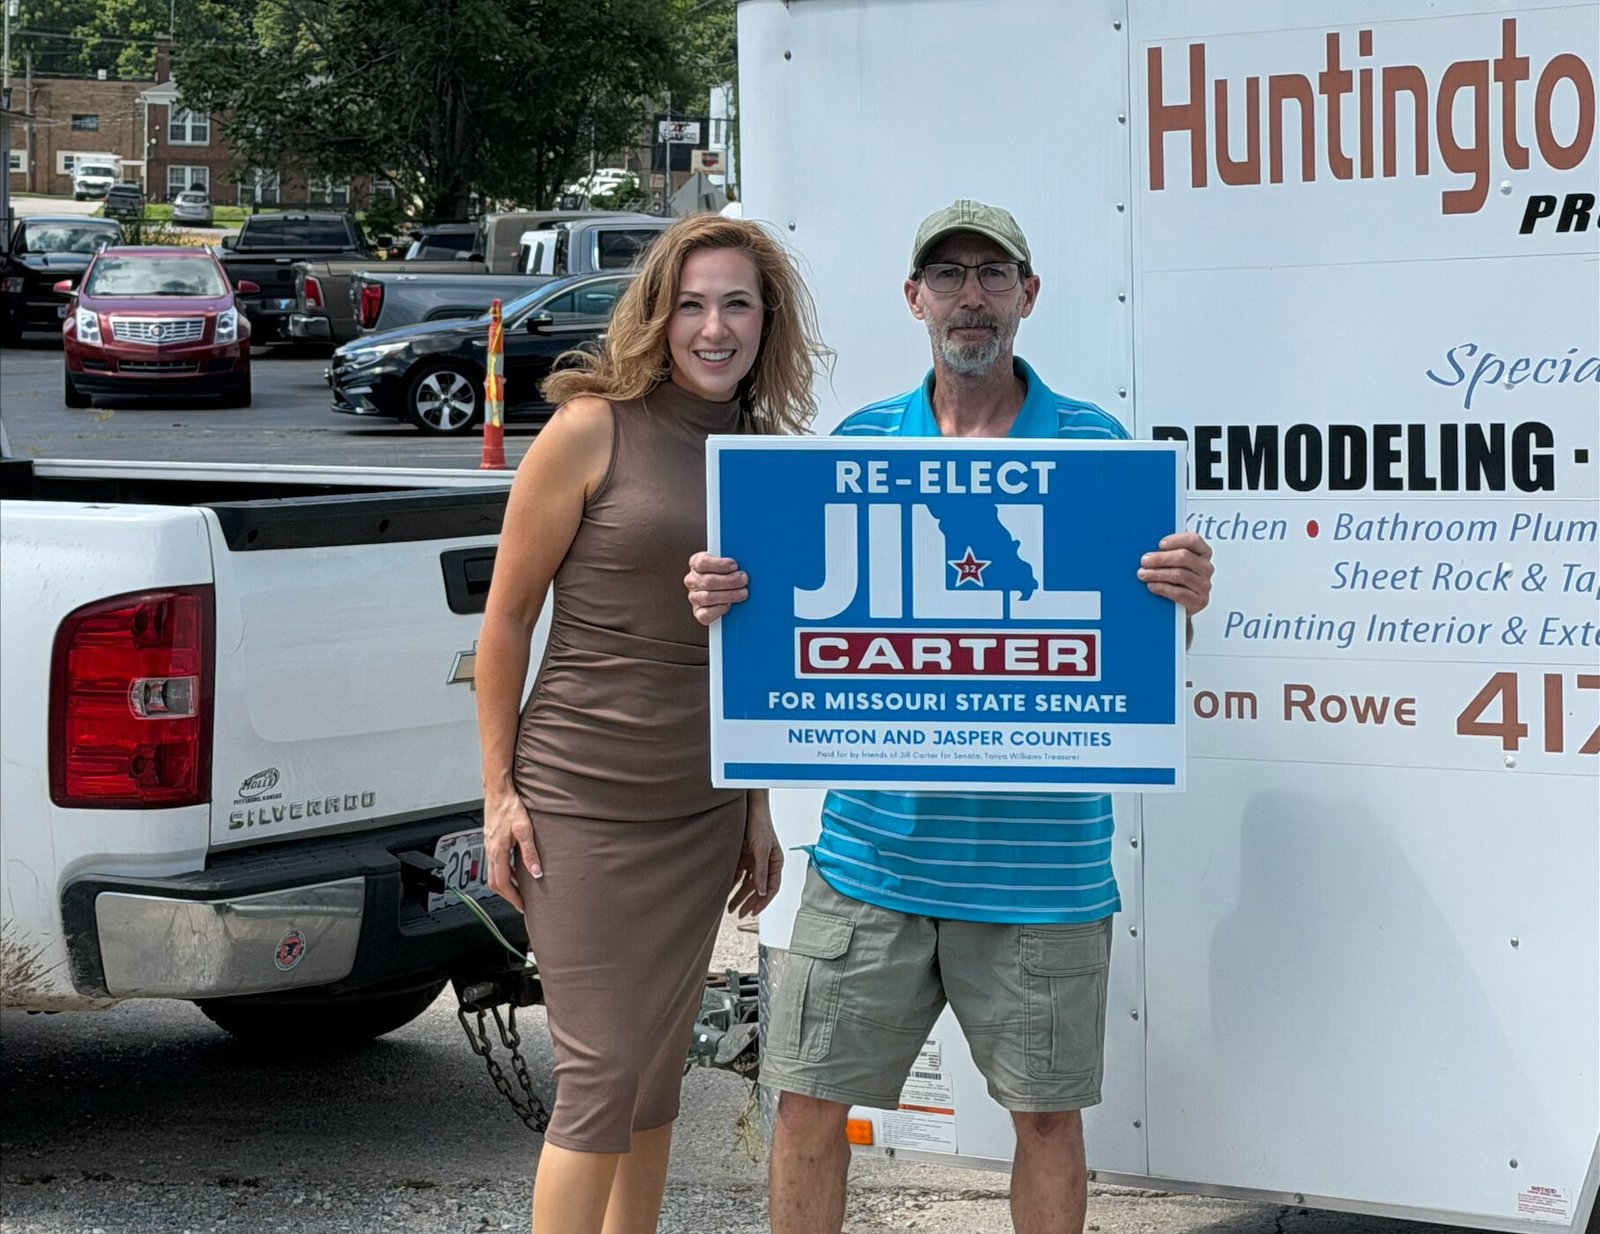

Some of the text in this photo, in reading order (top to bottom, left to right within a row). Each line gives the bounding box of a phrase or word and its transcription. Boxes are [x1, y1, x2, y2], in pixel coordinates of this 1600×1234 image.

[1147, 18, 1596, 215] Huntingto
[1518, 193, 1600, 235] PR
[836, 460, 1056, 495] RE-ELECT
[1333, 512, 1498, 542] Bathroom
[793, 503, 1101, 621] JILL
[963, 564, 977, 573] 32
[1331, 561, 1600, 601] Sheet Rock & Ta
[1224, 611, 1600, 649] Painting Interior & Ext
[808, 637, 1089, 672] CARTER
[768, 691, 1127, 713] FOR MISSOURI STATE SENATE
[1186, 681, 1258, 720] om
[788, 728, 1112, 747] NEWTON AND JASPER COUNTIES
[850, 751, 859, 759] by
[229, 790, 376, 830] SILVERADO
